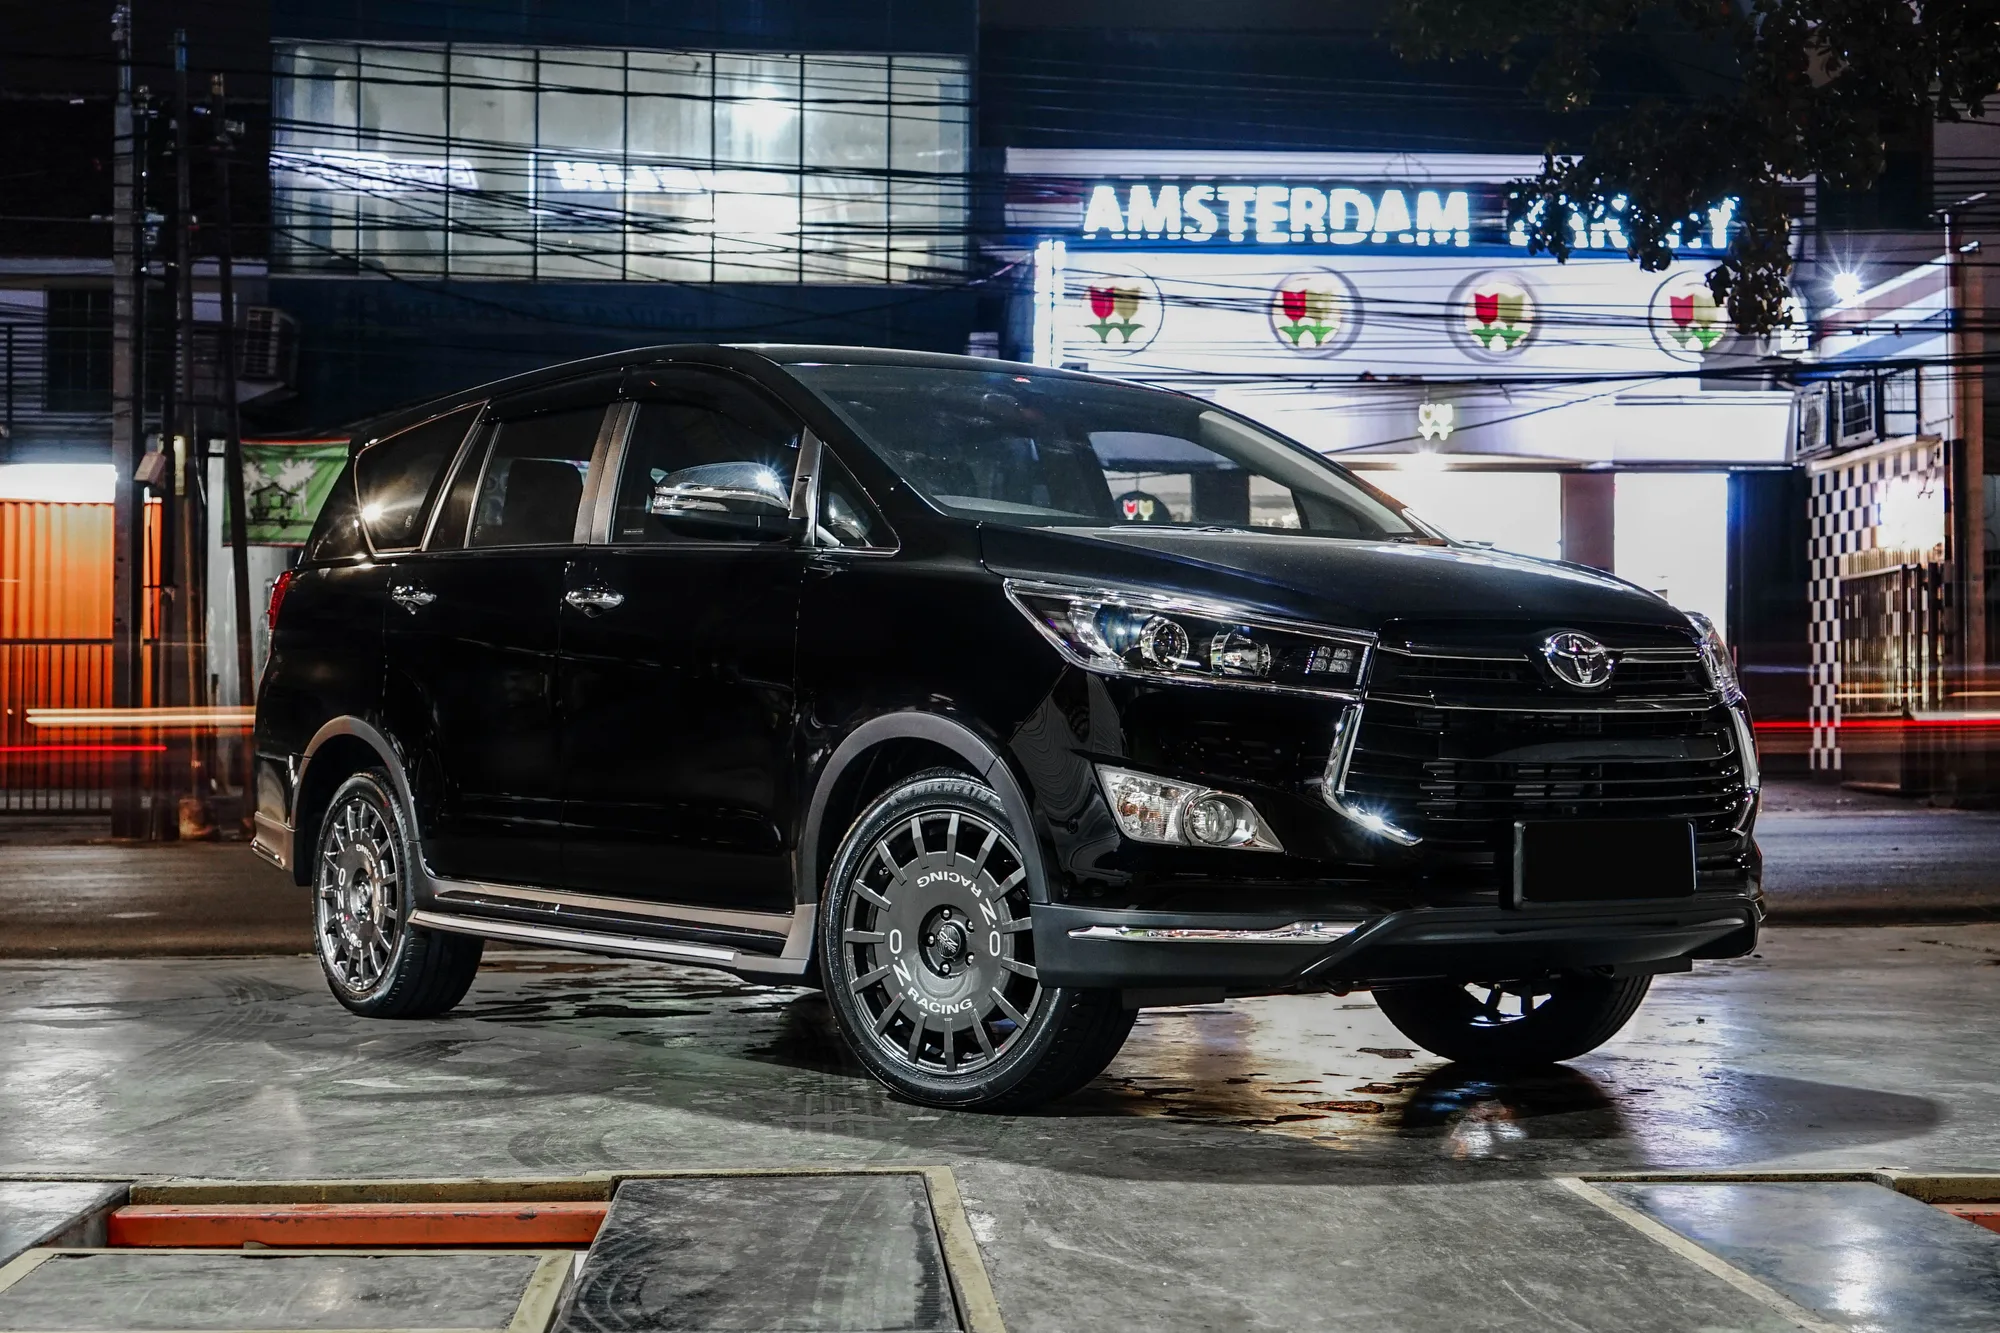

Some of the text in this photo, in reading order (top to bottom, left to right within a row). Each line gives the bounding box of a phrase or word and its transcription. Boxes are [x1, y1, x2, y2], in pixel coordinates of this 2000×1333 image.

[1082, 185, 1470, 247] AMSTERDAM
[917, 871, 982, 898] RACING
[907, 987, 973, 1015] RACING
